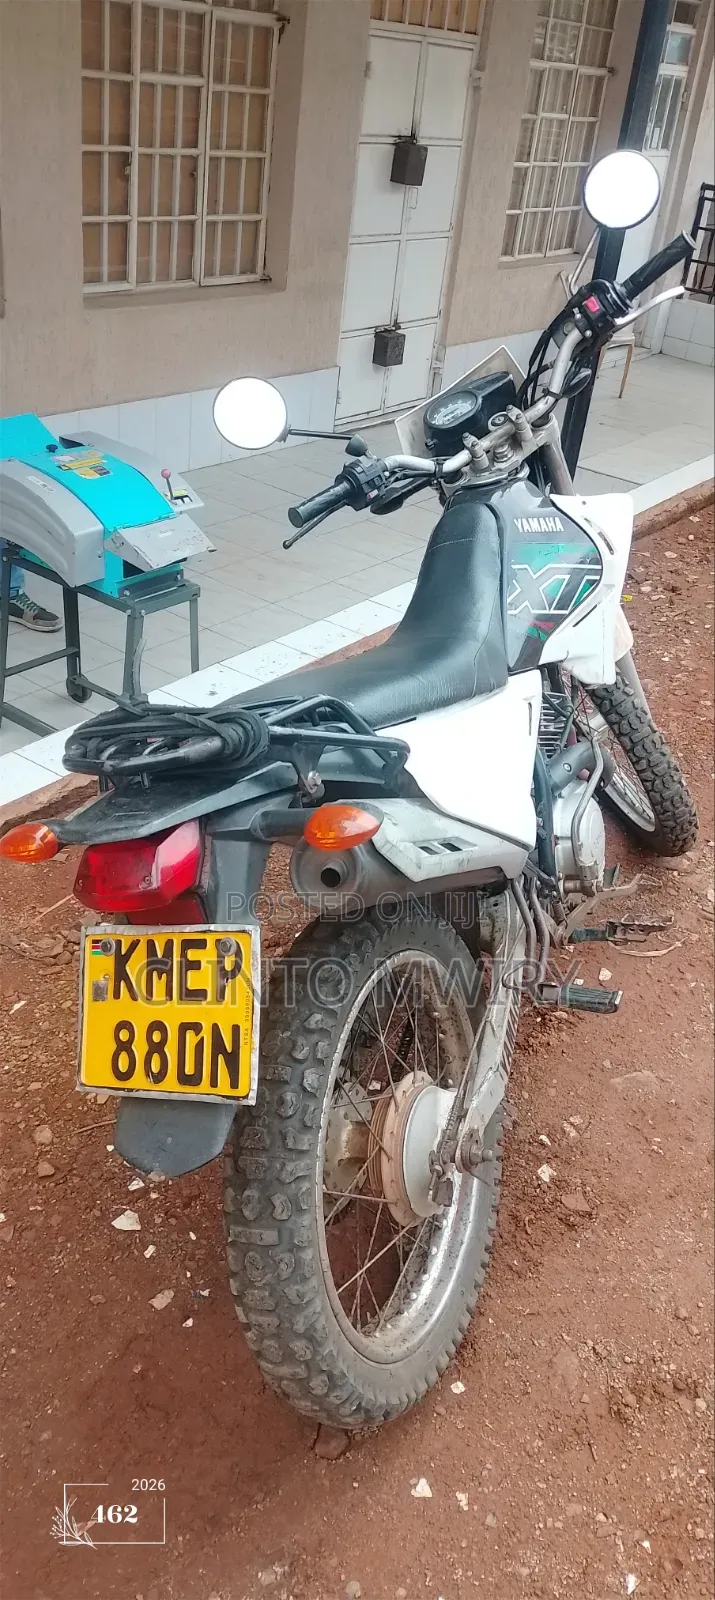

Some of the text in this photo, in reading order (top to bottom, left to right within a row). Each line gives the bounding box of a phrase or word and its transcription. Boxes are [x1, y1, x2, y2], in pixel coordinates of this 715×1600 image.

[513, 516, 564, 533] YAMAHA
[507, 563, 602, 615] XT
[112, 938, 243, 1002] KMEP
[111, 1020, 241, 1089] 880N
